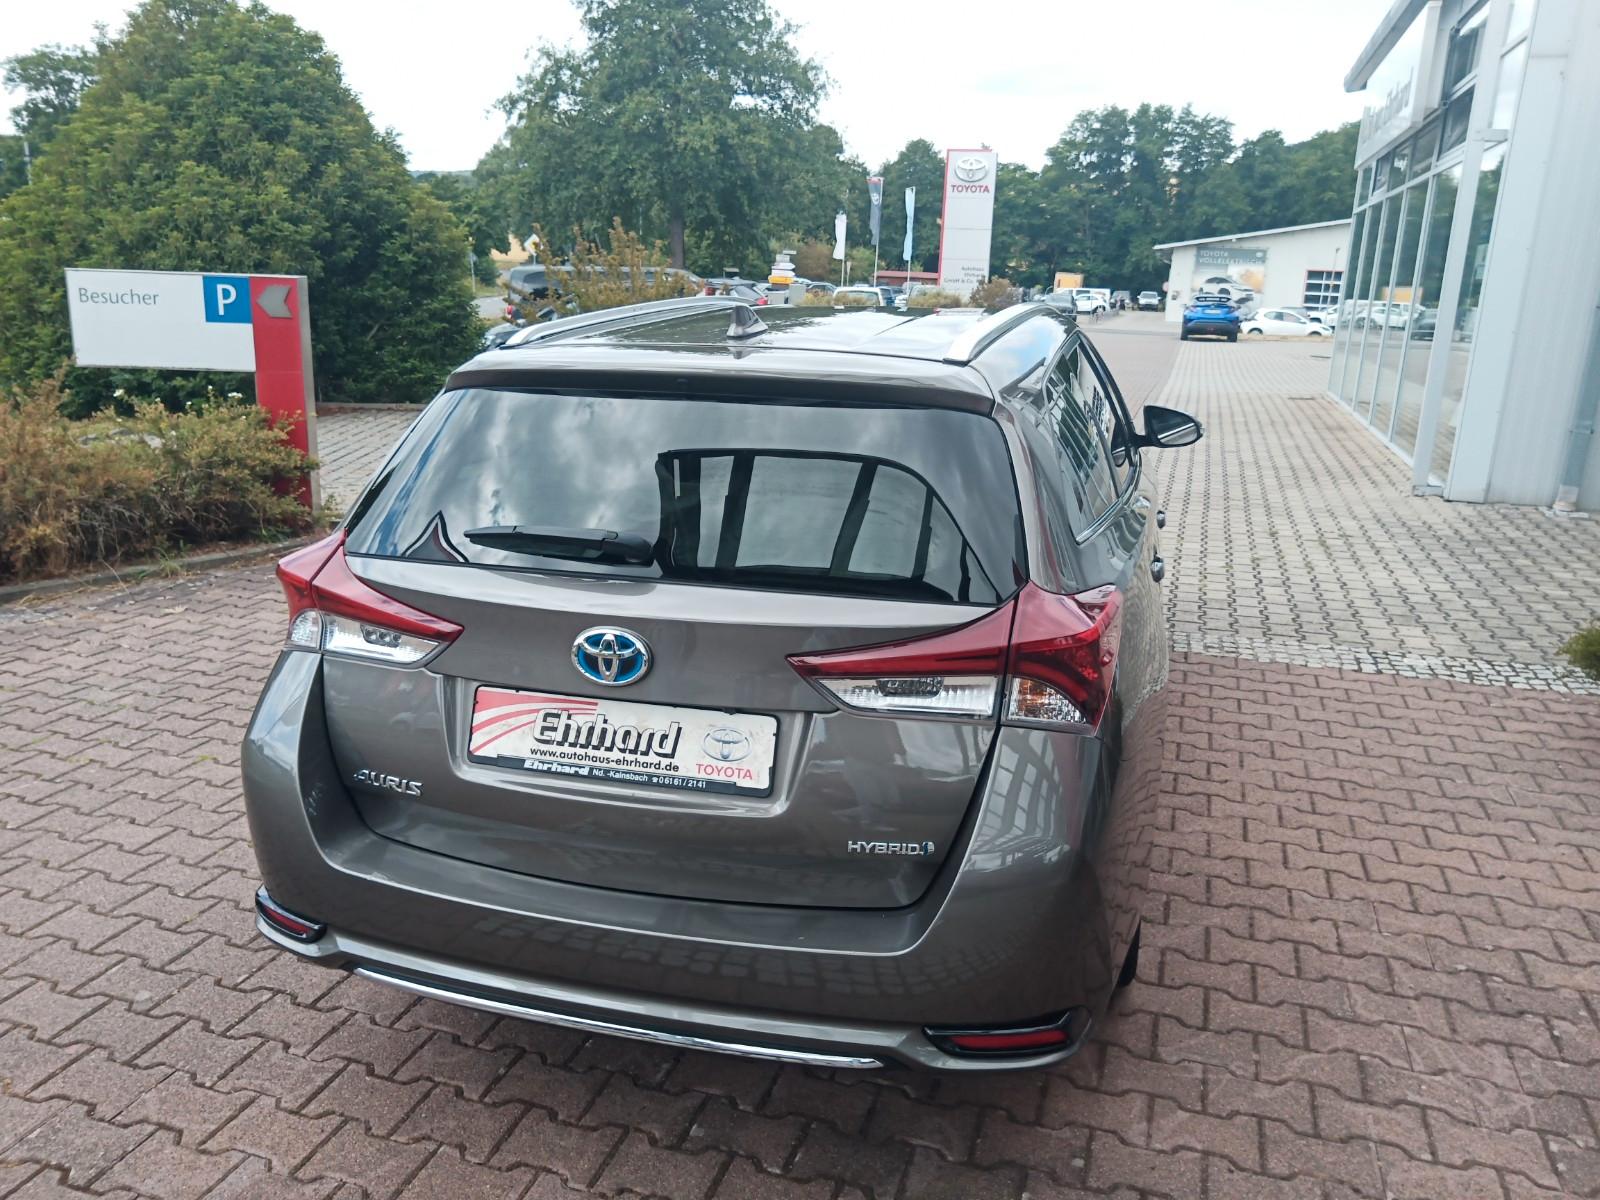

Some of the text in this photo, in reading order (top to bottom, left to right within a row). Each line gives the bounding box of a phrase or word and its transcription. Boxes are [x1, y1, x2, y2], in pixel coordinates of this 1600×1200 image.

[951, 184, 991, 194] TOYOTA
[78, 284, 237, 316] Besucher P
[533, 708, 683, 759] Ehrhard
[523, 758, 590, 776] Ehrhard
[530, 747, 679, 772] www.autohaus-ehrhard.de
[695, 763, 753, 780] TOYOTA
[353, 769, 423, 797] AURIS
[847, 840, 920, 855] HYBRID
